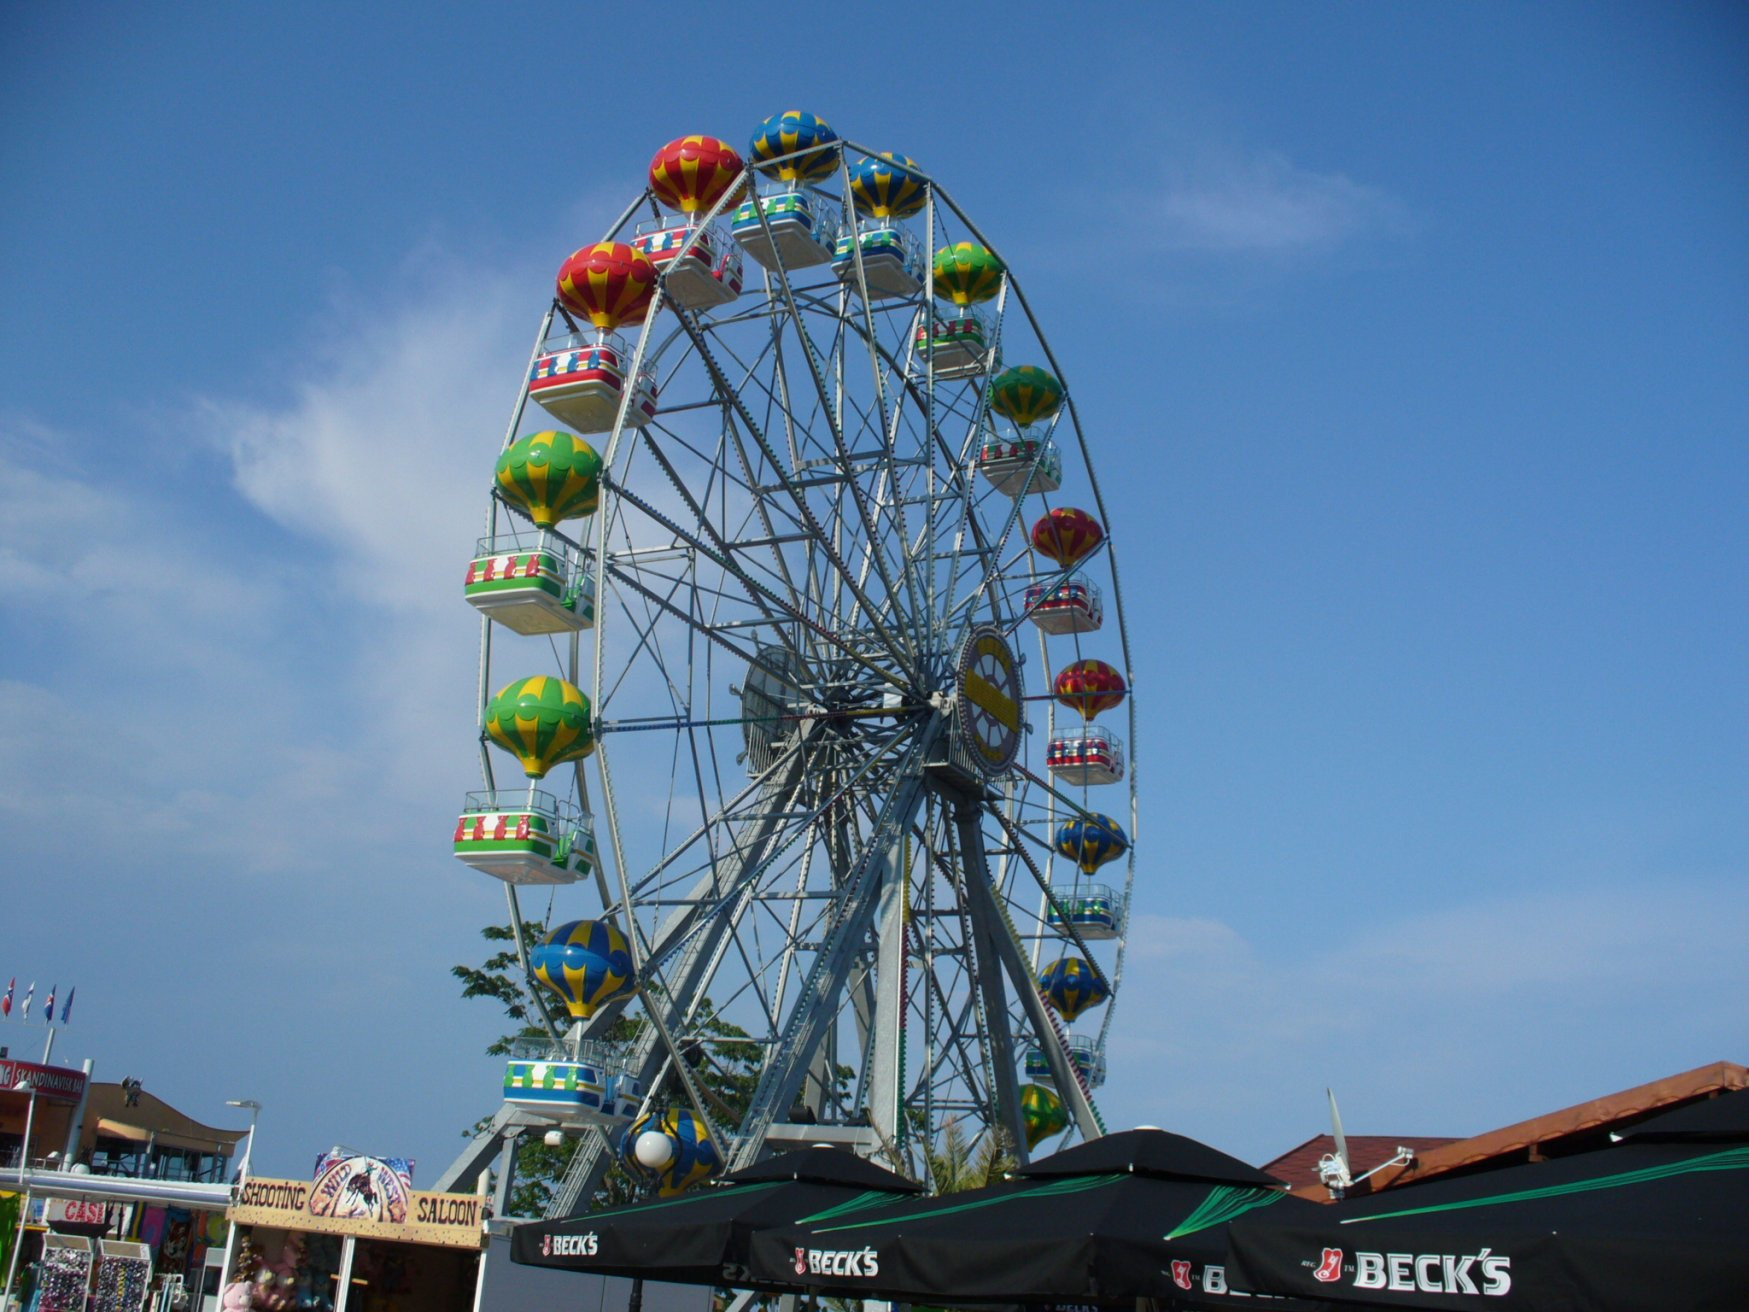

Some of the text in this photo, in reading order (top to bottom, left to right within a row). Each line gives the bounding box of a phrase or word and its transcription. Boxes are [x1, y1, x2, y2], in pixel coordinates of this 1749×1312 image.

[320, 1163, 401, 1206] WILD WEST
[417, 1197, 478, 1227] SALOON
[553, 1231, 598, 1256] BECK'S
[808, 1246, 879, 1277] BECK'S
[1353, 1248, 1512, 1296] BECK'S
